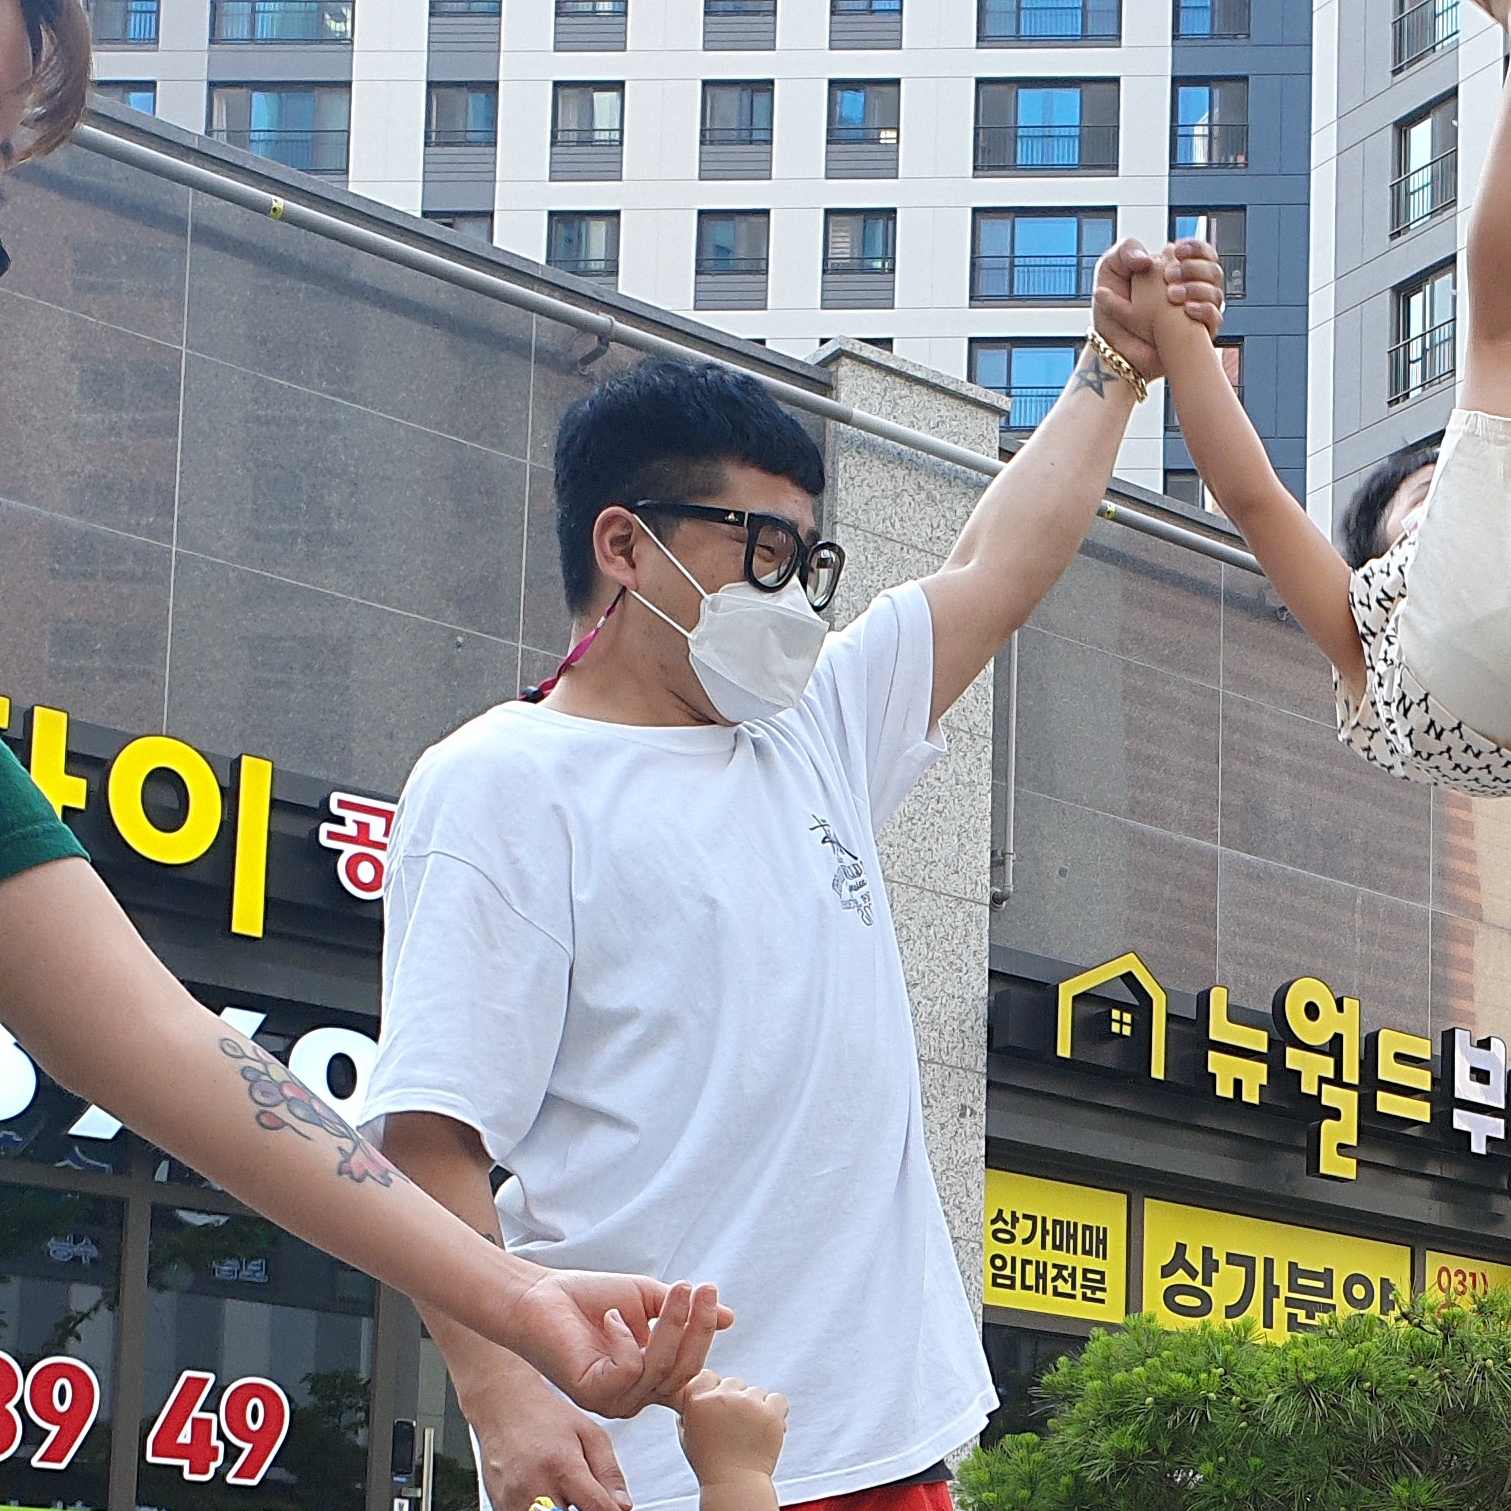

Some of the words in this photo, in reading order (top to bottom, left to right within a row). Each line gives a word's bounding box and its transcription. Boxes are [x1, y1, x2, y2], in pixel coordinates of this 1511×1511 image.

[990, 1208, 1108, 1261] 상가매매
[989, 1252, 1107, 1304] 임대전문
[1437, 1265, 1488, 1296] 031)
[146, 1370, 290, 1485] 49
